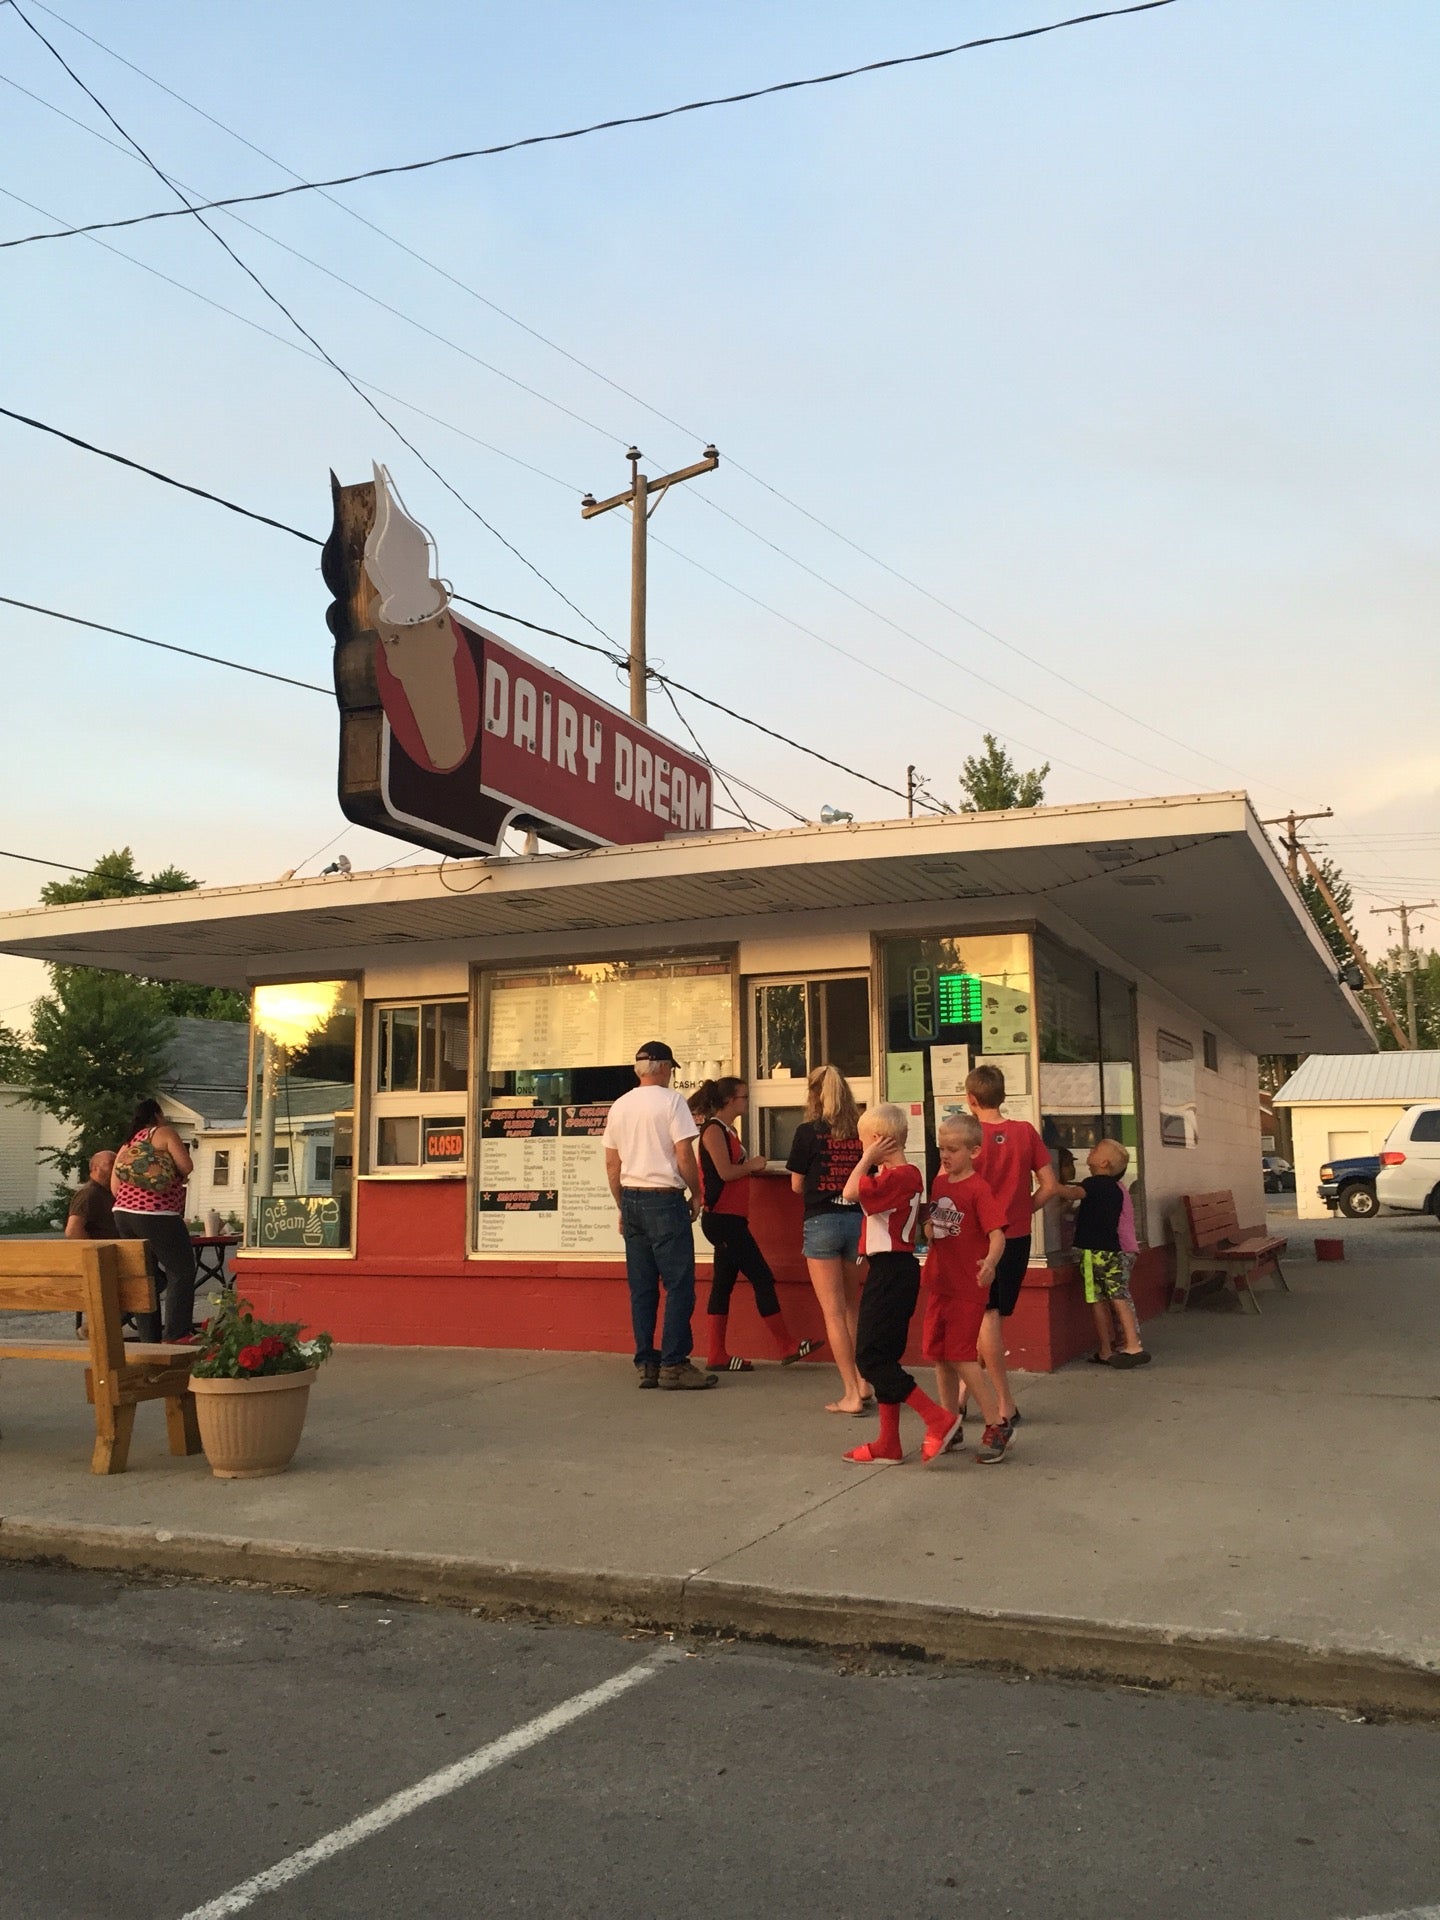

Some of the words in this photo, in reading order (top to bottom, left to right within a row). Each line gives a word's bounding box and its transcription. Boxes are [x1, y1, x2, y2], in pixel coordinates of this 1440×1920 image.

[484, 658, 602, 784] DAIRY
[615, 732, 707, 831] DREAM
[913, 967, 933, 1038] OPEN
[673, 1080, 695, 1089] CASH
[428, 1135, 462, 1155] CLOSED
[265, 1205, 288, 1223] Ice
[264, 1216, 305, 1240] Cream
